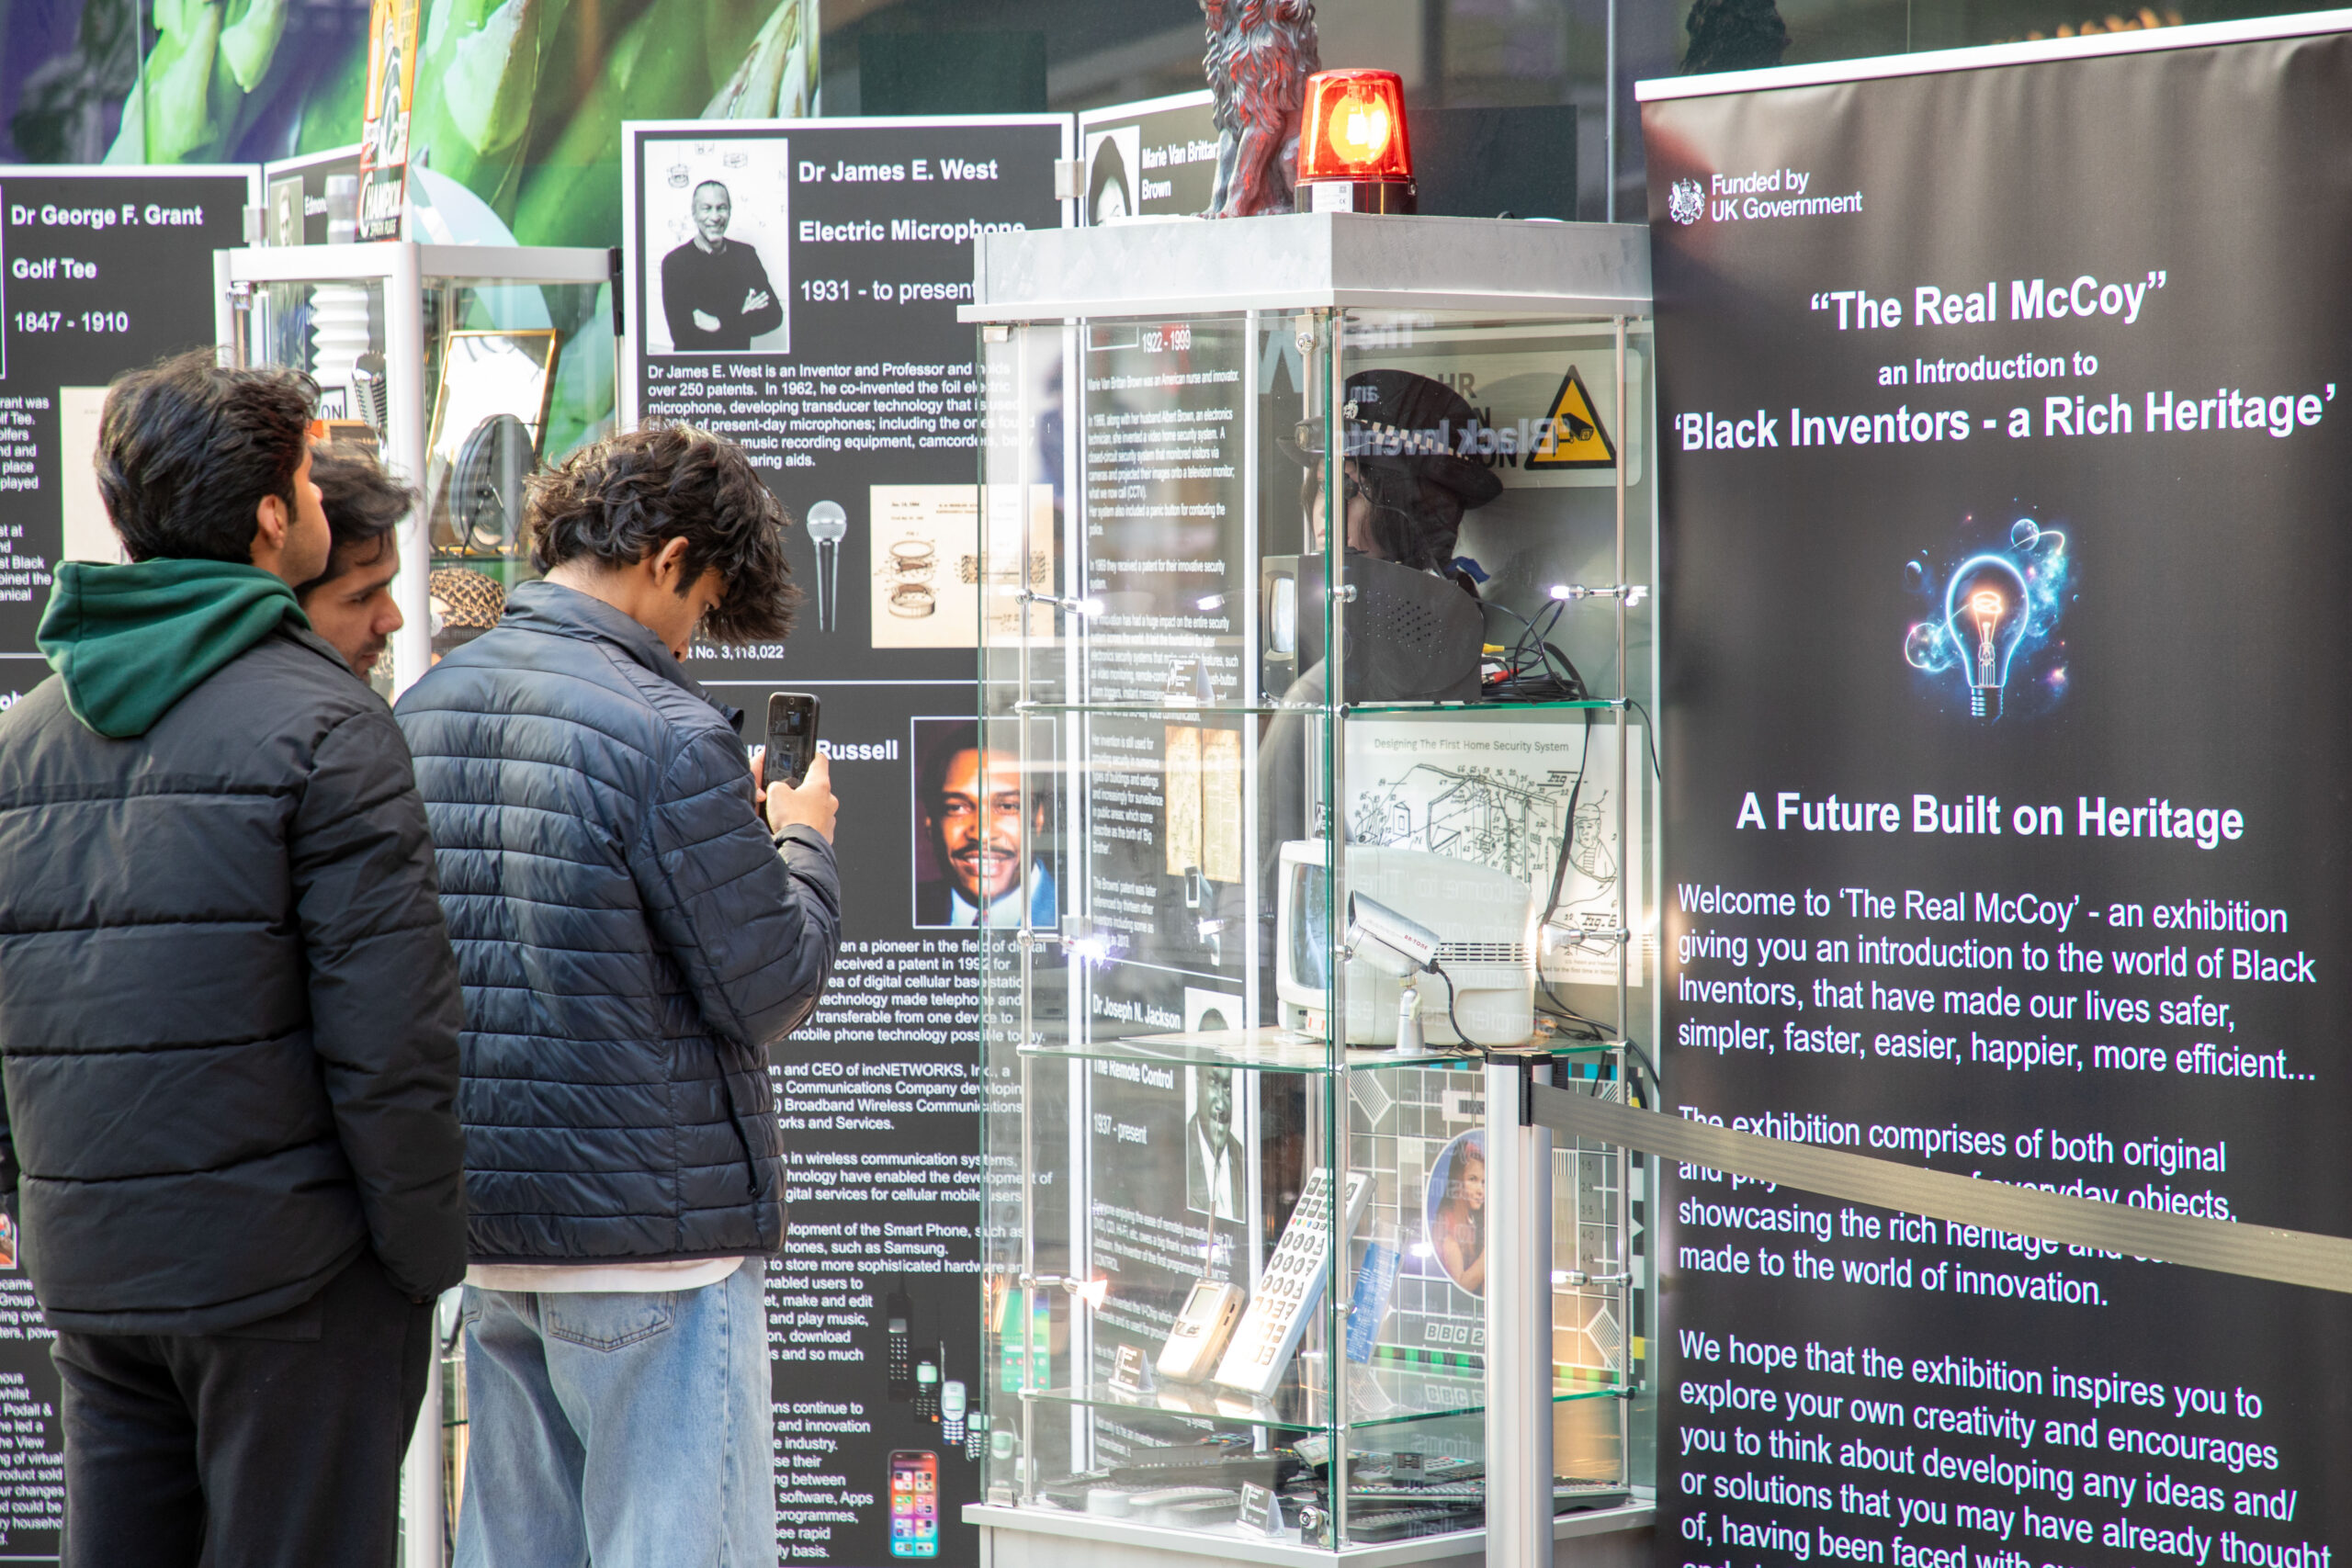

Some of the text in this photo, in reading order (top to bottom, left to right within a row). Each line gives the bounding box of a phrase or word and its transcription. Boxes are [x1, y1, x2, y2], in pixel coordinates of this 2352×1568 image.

[1142, 145, 1168, 169] Marie
[1168, 143, 1187, 165] Van
[798, 158, 999, 183] Dr James E. West
[1142, 178, 1171, 200] Brown
[1712, 168, 1811, 196] Funded by
[10, 204, 204, 230] Dr George F. Grant
[1712, 191, 1863, 222] UK Government
[799, 220, 885, 243] Electric
[11, 257, 97, 279] Golf Tee
[800, 279, 850, 301] 1931
[871, 280, 894, 301] to
[1810, 271, 2167, 330] “The Real McCoy”
[14, 311, 62, 333] 1847
[80, 310, 129, 333] 1910
[1142, 332, 1163, 354] 1922
[1170, 329, 1192, 352] 1999
[647, 361, 973, 379] Dr James E. West is an Inventor and Professor and
[1877, 351, 2099, 386] an Introduction to
[647, 379, 962, 399] over 250 patents. In 1962, he co-invented the foil
[24, 397, 51, 410] was
[648, 398, 973, 417] microphone, developing transducer technology that
[1675, 384, 2336, 450] ‘Black Inventors - a Rich Heritage’
[1, 459, 35, 476] place
[11, 555, 45, 570] Black
[695, 644, 785, 660] No. 3,118,022
[816, 739, 899, 761] Russell
[1374, 738, 1570, 754] Designing The First Home Security System
[1736, 791, 2245, 850] A Future Built on Heritage
[1676, 884, 1797, 920] Welcome
[1804, 887, 1831, 918] to
[1838, 887, 1896, 919] ‘The
[1905, 889, 1966, 921] Real
[1974, 892, 2080, 931] McCoy’
[2108, 903, 2144, 928] an
[2153, 898, 2288, 933] exhibition
[1674, 928, 2317, 983] giving you an introduction to the world of Black
[1092, 993, 1182, 1031] Dr Joseph N. Jackson
[1676, 973, 2235, 1032] Inventors, that have made our lives safer,
[1678, 1020, 2316, 1080] simpler, faster, easier, happier, more efficient...
[783, 1062, 968, 1077] and CEO of incNETWORKS,
[1109, 1060, 1140, 1083] Remote
[1141, 1064, 1174, 1089] Control
[784, 1098, 914, 1112] Broadband Wireless
[808, 1116, 895, 1131] and Services.
[1093, 1112, 1113, 1135] 1937
[1117, 1122, 1148, 1145] present
[790, 1151, 958, 1166] in wireless communication
[842, 1222, 972, 1238] of the Smart Phone,
[830, 1240, 949, 1258] such as Samsung.
[1426, 1324, 1485, 1344] BBC 2
[778, 1490, 875, 1507] software, Apps
